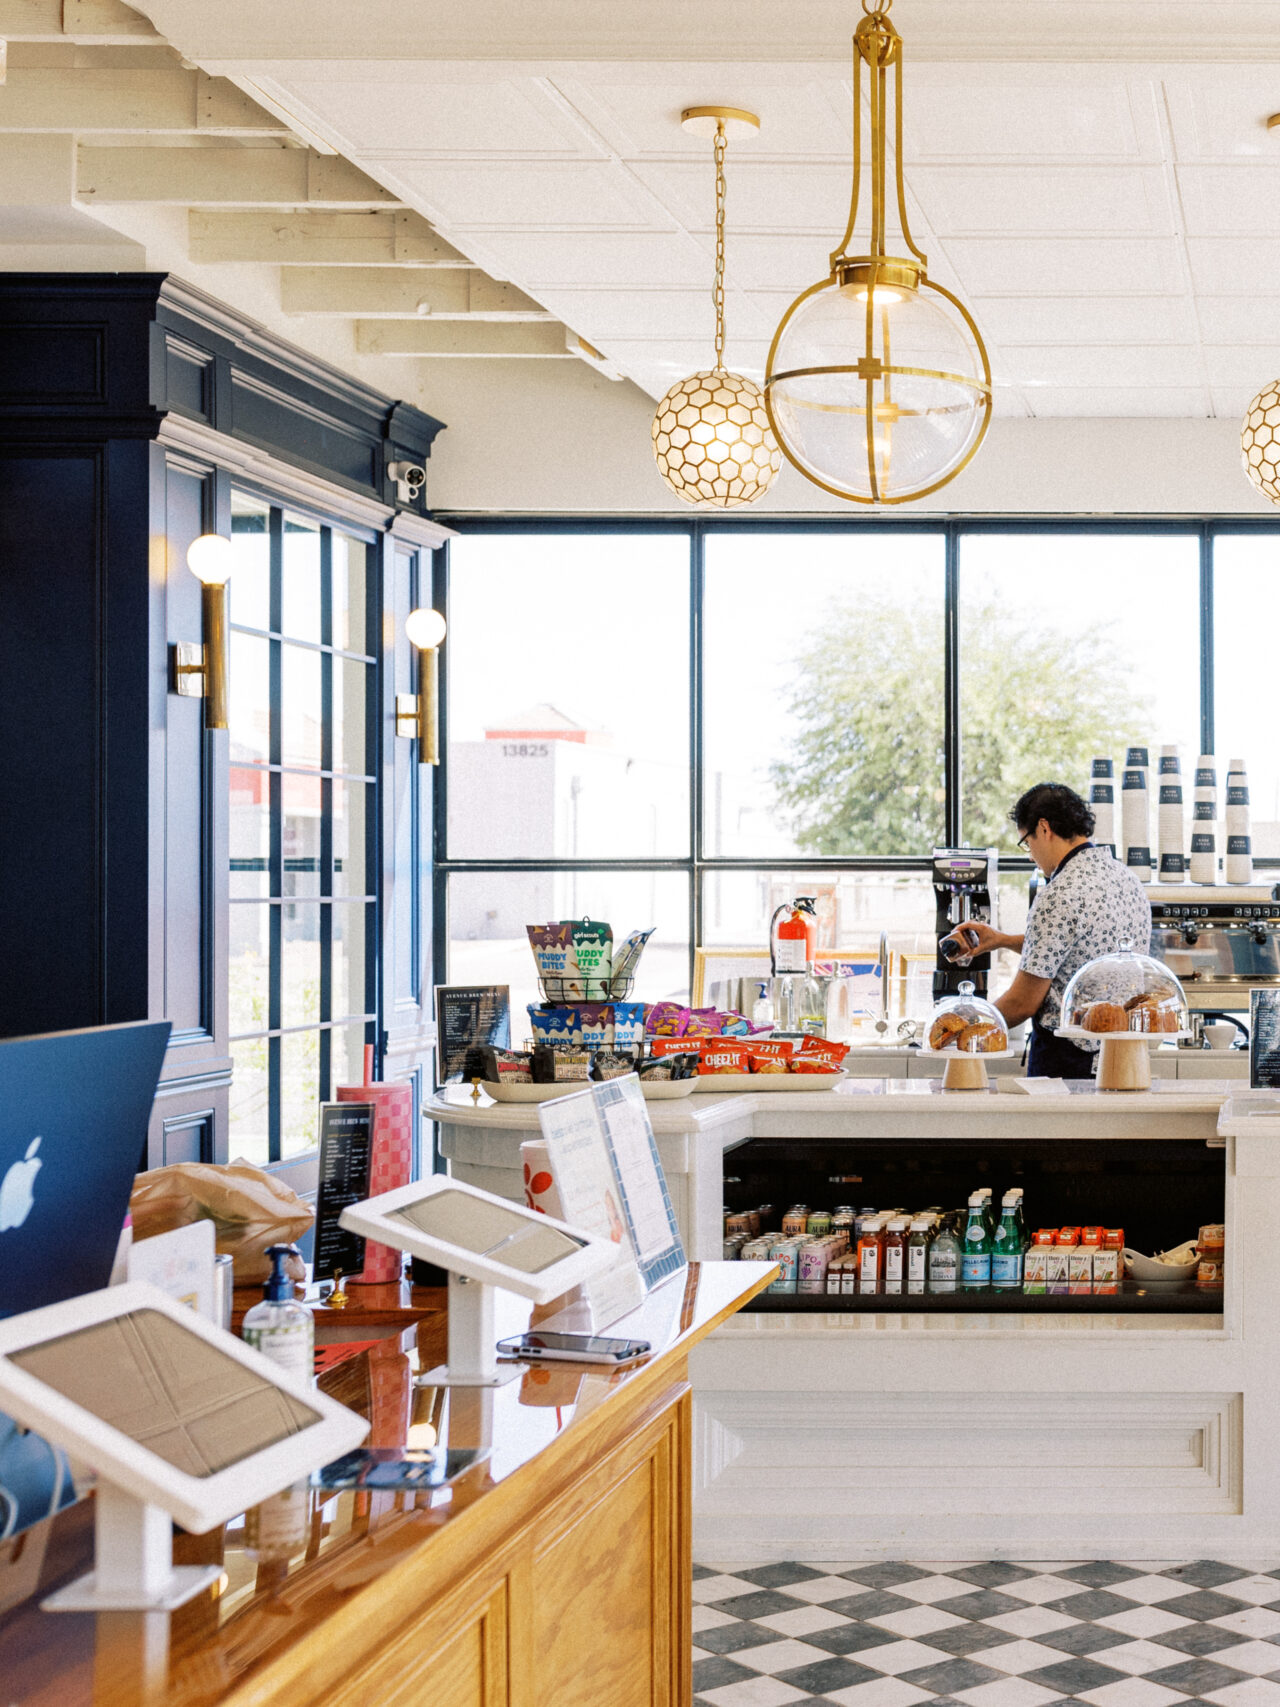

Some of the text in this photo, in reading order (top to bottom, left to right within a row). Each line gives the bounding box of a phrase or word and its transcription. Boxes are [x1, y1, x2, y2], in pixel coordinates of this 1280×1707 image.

[502, 744, 548, 757] 13825
[538, 952, 567, 961] MUDDY
[576, 950, 604, 958] UDDY
[542, 962, 565, 970] BITES
[583, 1032, 606, 1040] DDY
[800, 1254, 821, 1266] LIPOP
